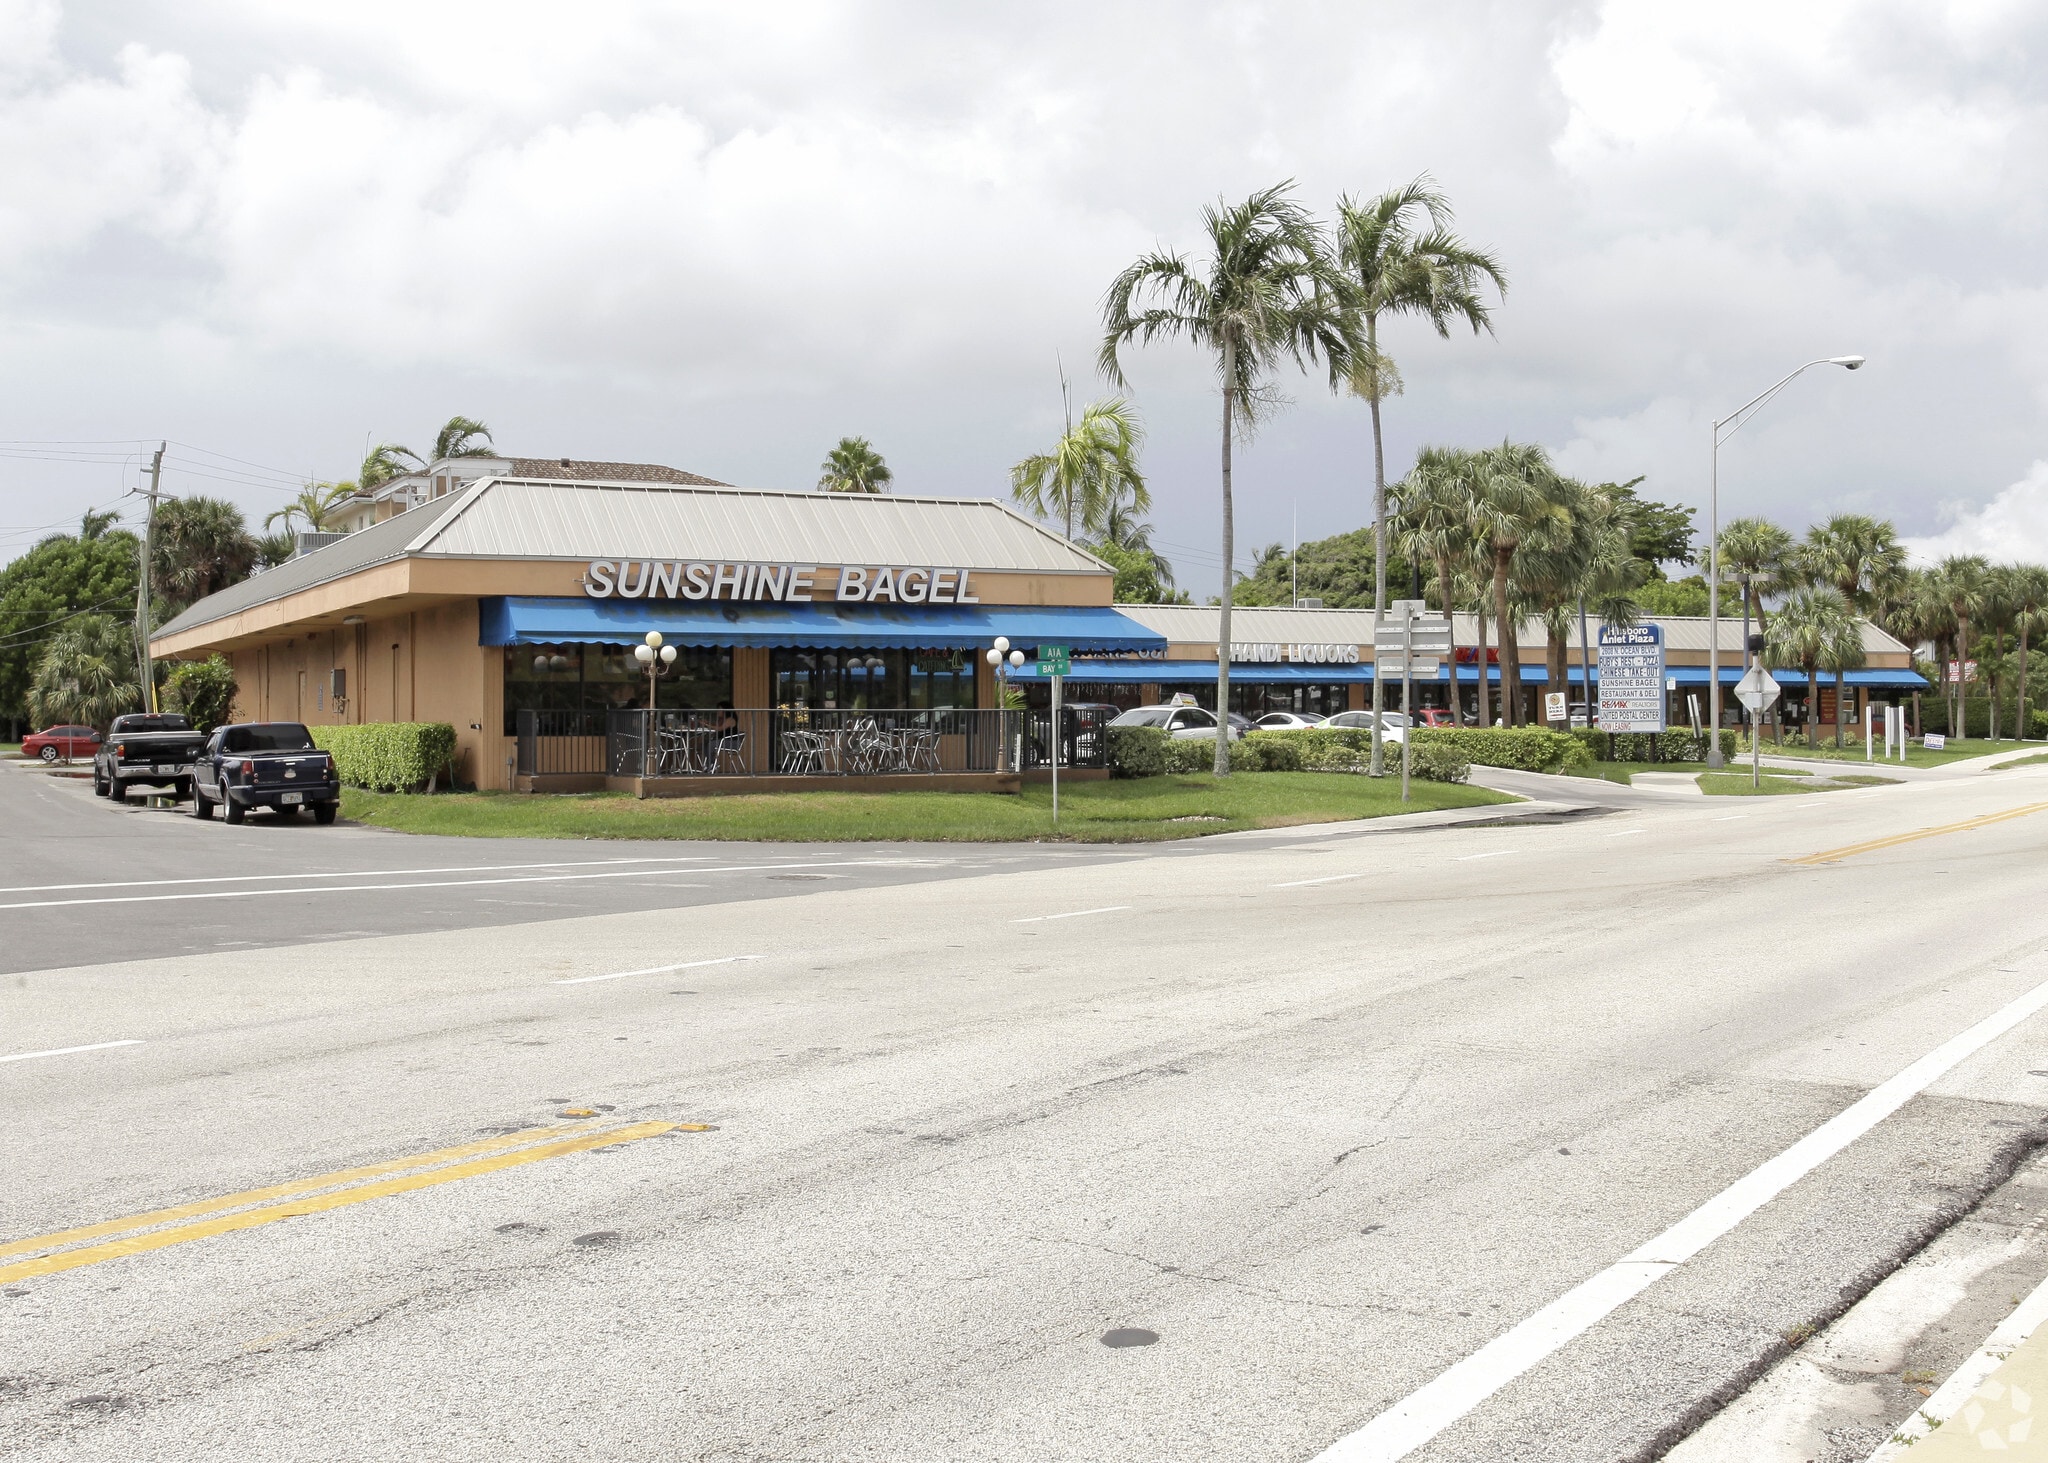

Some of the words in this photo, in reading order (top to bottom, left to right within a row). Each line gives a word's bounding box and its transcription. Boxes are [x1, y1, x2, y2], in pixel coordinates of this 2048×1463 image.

[584, 560, 817, 602] SUNSHINE
[836, 566, 980, 604] BAGEL
[1629, 634, 1654, 643] Plaza
[1047, 648, 1062, 657] A1A
[1288, 643, 1359, 663] LIQUORS
[1620, 646, 1639, 655] OCEAN
[1600, 656, 1619, 667] RUBY'S
[1643, 655, 1659, 666] PIZZA
[1042, 665, 1055, 673] BAY
[1600, 667, 1625, 677] CHINESE
[1629, 667, 1658, 677] TAKE-OUT
[1601, 690, 1638, 698] RESTAURANT
[1602, 700, 1628, 709] RE/MAX
[1601, 711, 1618, 719] UNITED
[1620, 711, 1638, 719] POSTAL
[1640, 711, 1660, 719] CENTER
[1602, 722, 1611, 730] NOW
[1613, 722, 1631, 730] LEASING
